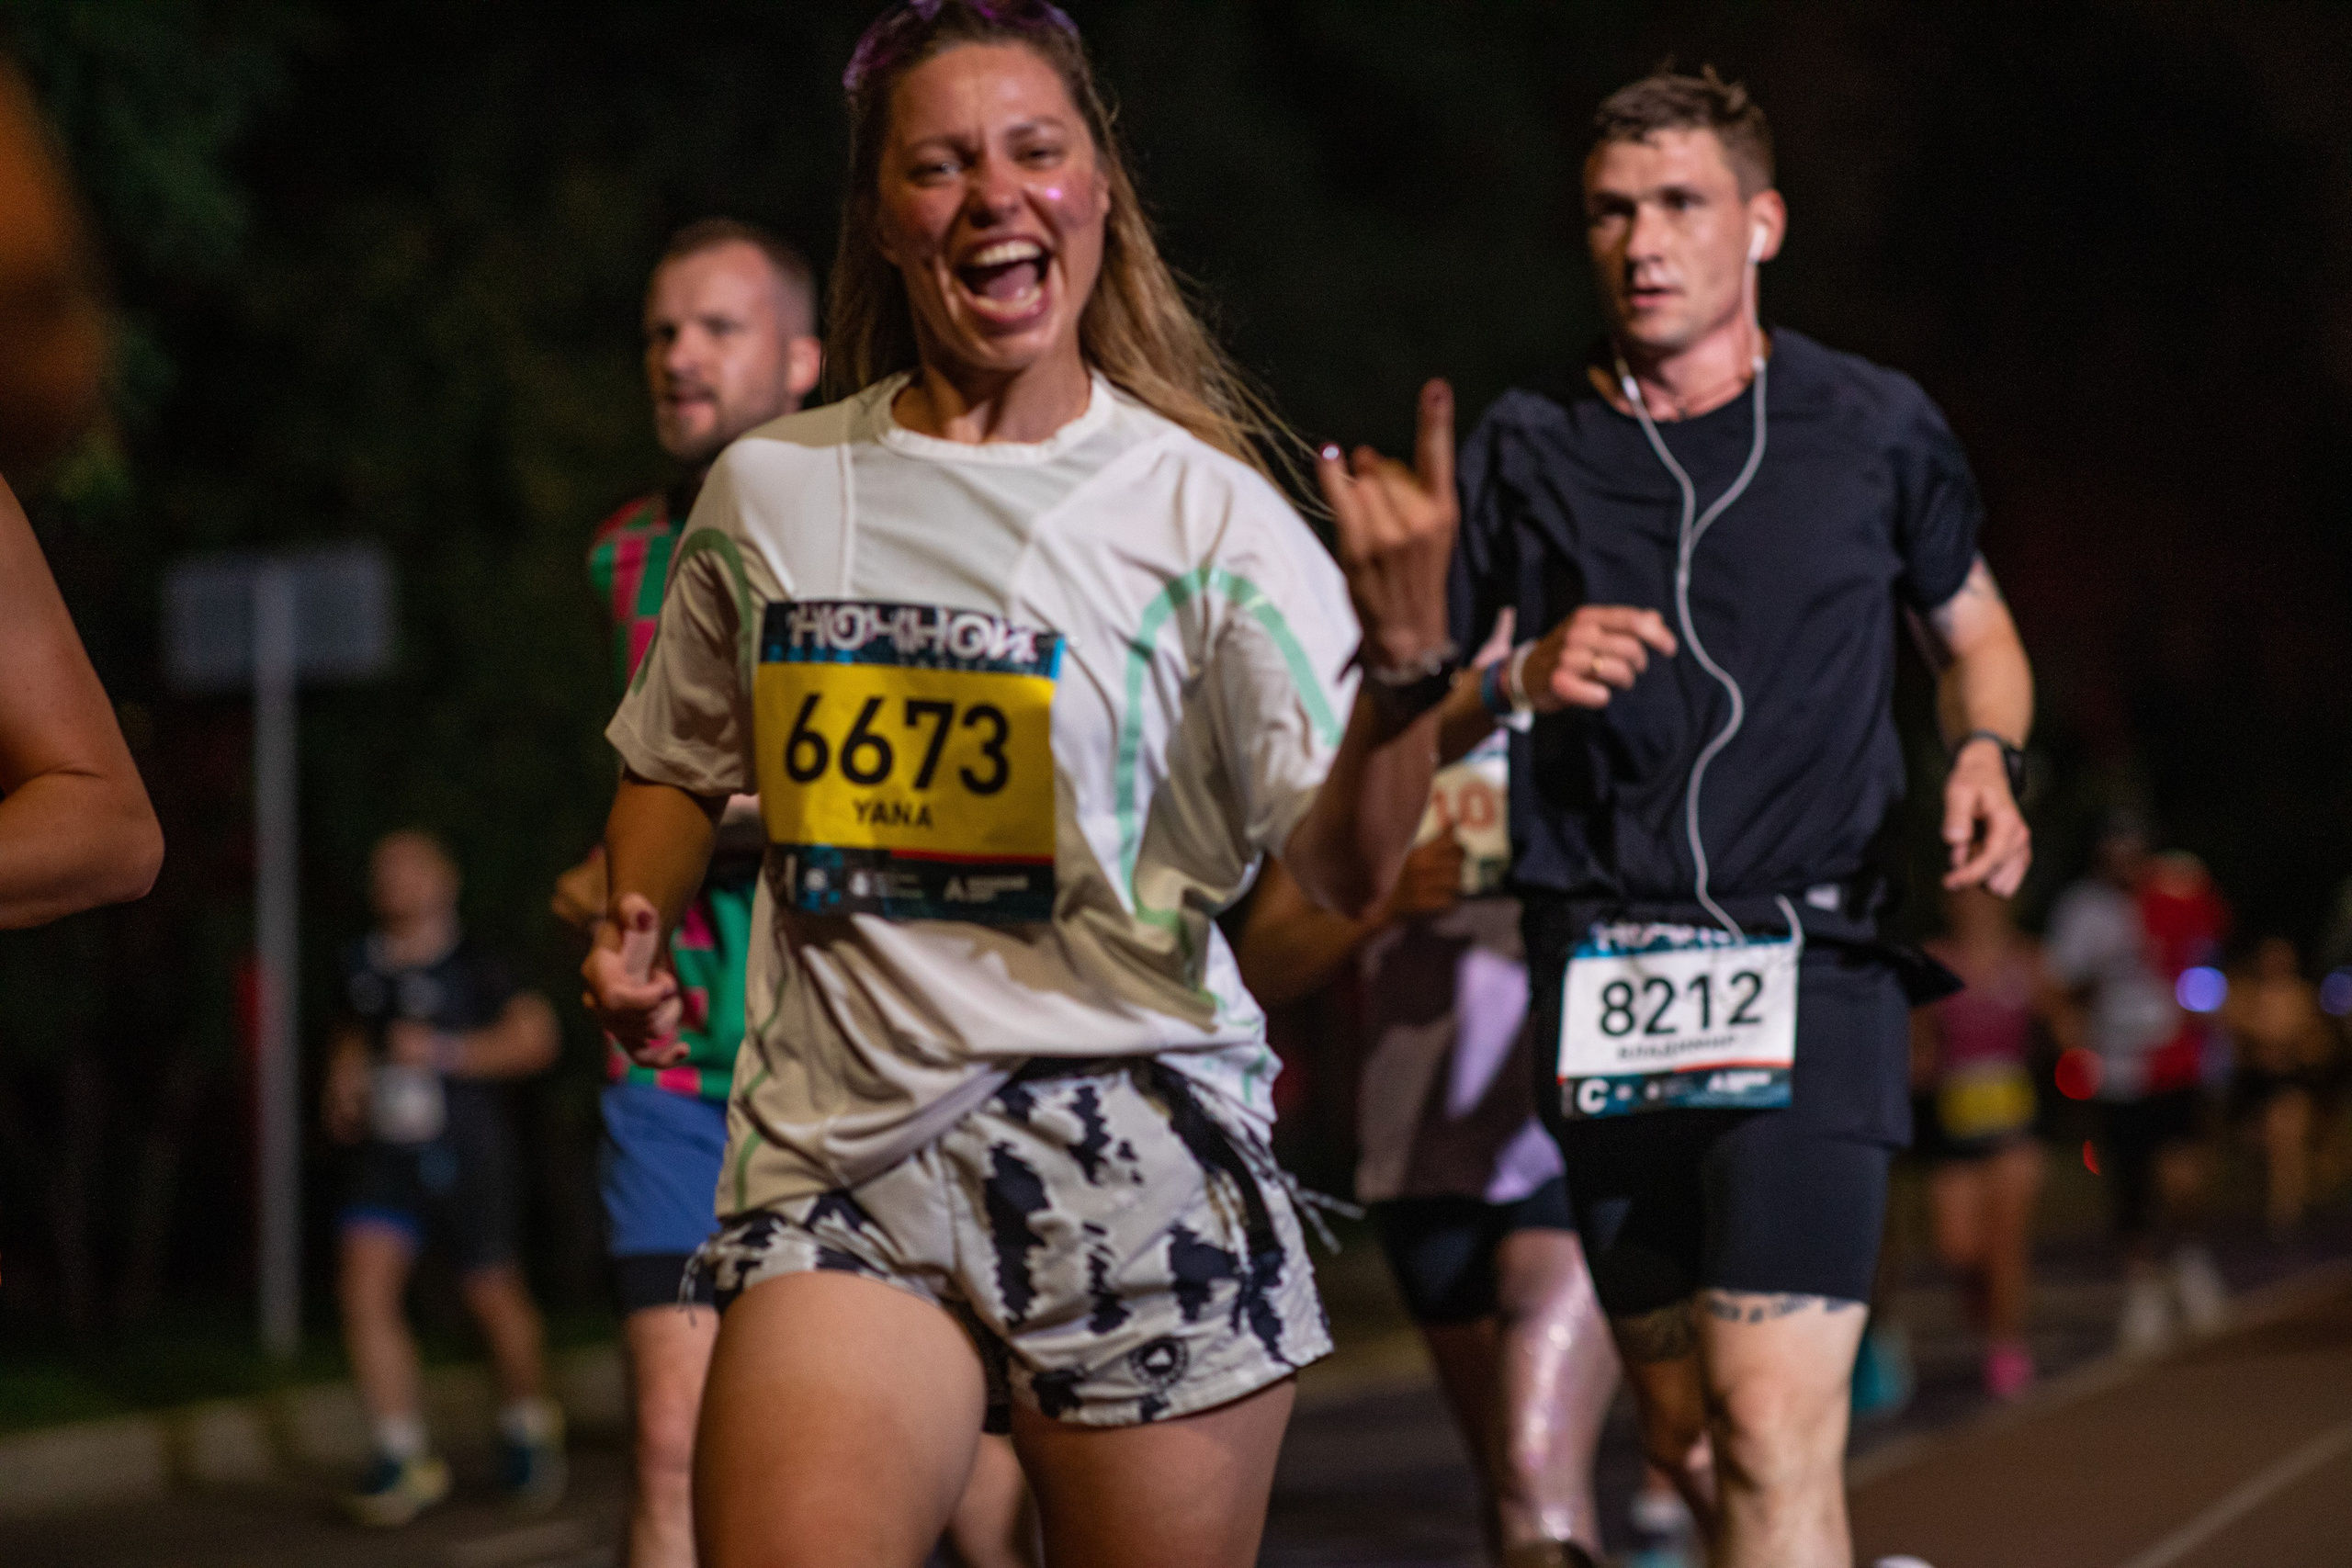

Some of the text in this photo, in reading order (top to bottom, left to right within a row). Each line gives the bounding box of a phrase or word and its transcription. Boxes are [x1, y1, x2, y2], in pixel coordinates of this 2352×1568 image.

[786, 692, 1010, 796] 6673
[853, 799, 933, 828] YANA
[1600, 970, 1763, 1038] 8212
